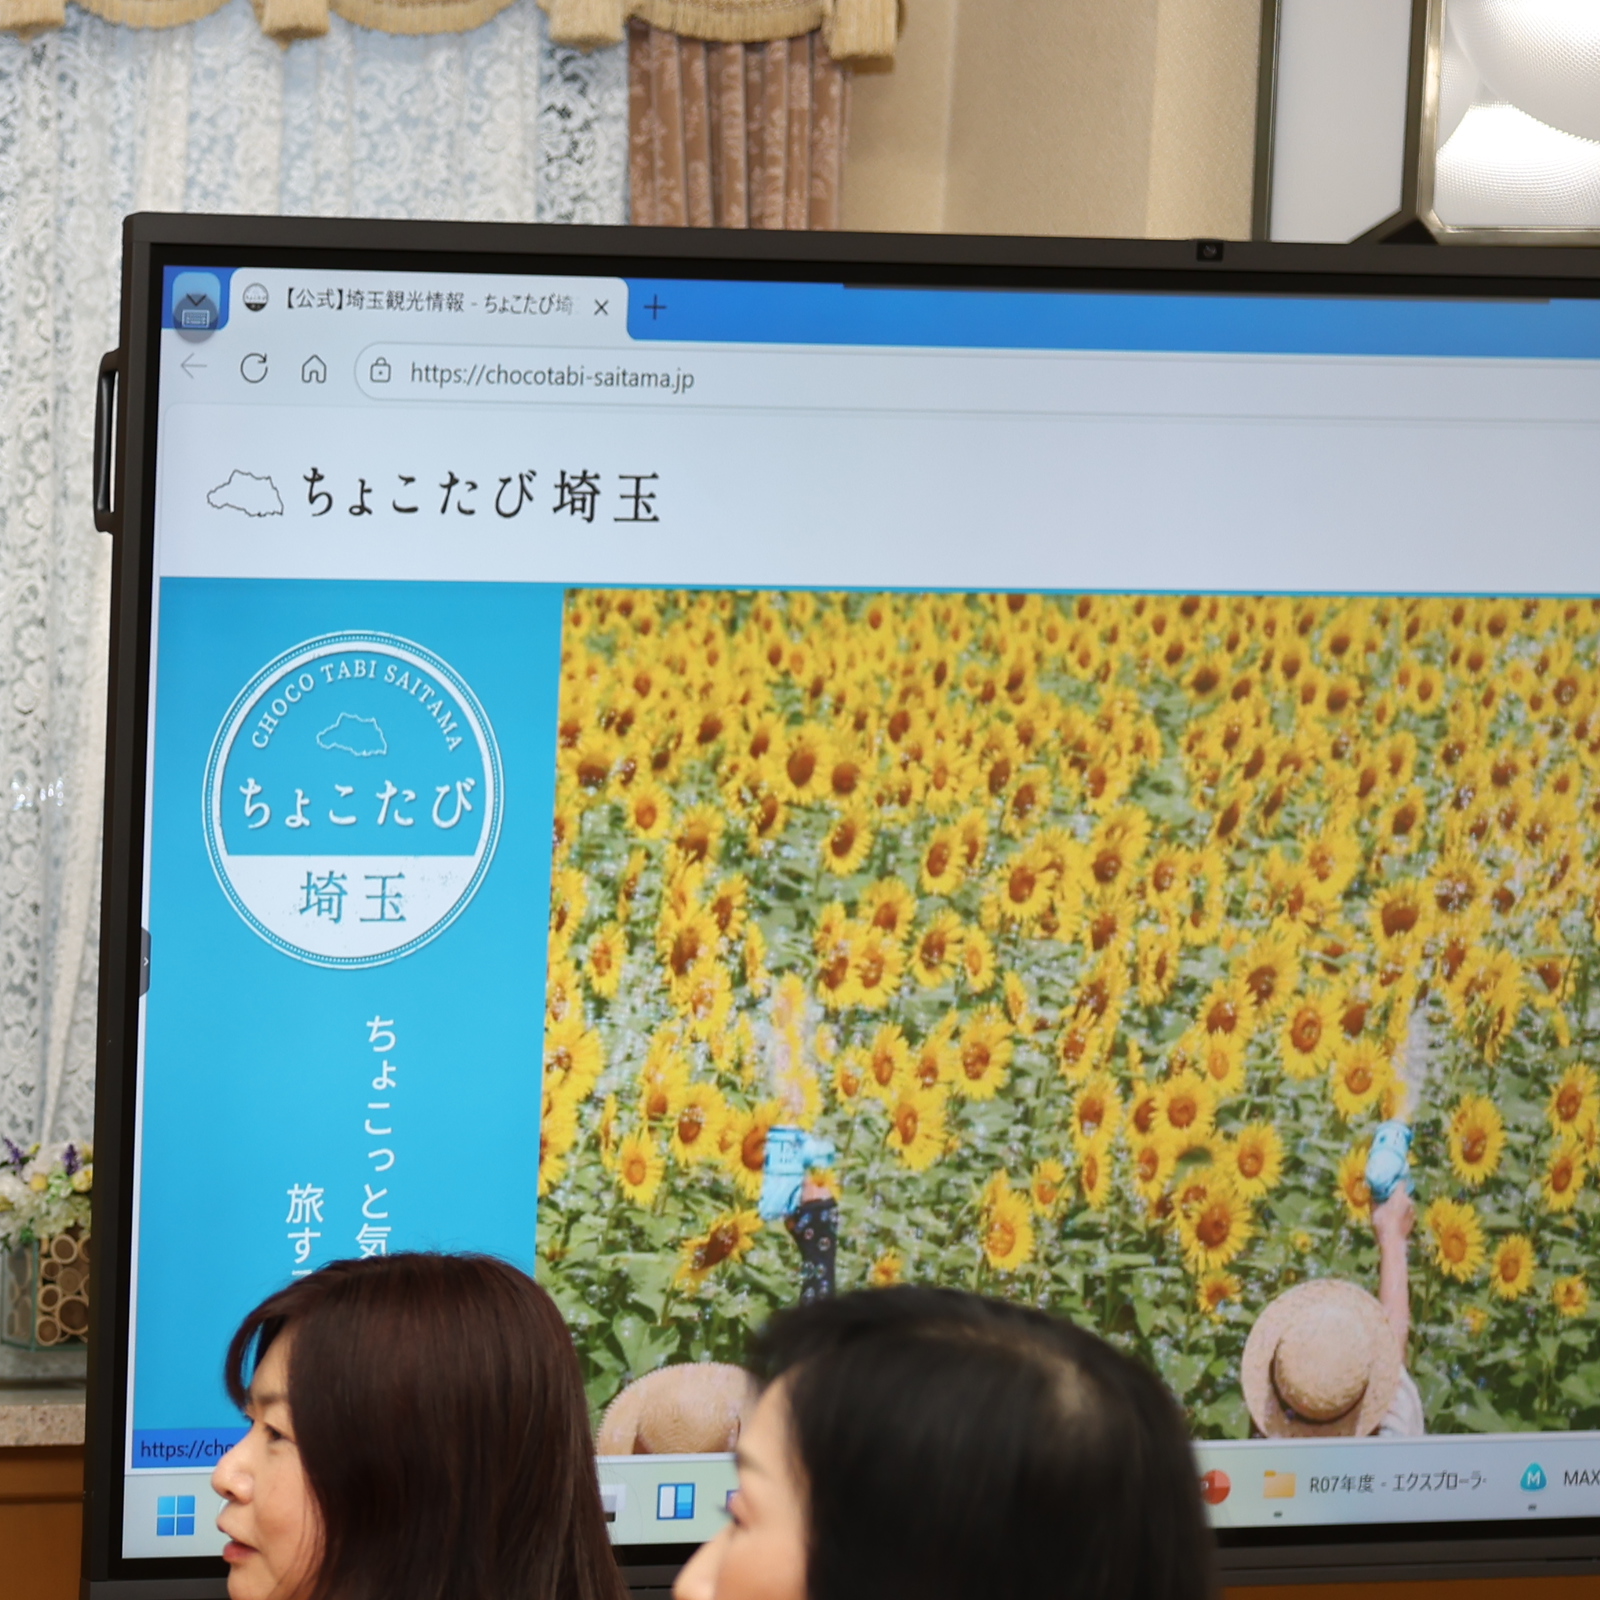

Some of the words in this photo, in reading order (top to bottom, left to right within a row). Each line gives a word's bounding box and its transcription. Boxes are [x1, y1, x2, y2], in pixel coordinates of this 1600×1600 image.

[287, 288, 464, 312] 【公式】埼玉観光情報
[411, 362, 695, 394] https://chocotabi-saitama.jp
[303, 467, 660, 523] ちょこたび埼玉
[252, 673, 314, 748] CHOCO
[320, 659, 377, 683] TABI
[384, 664, 463, 751] SAITAMA
[239, 777, 476, 828] ちょこたび
[300, 869, 407, 924] 埼玉
[355, 1014, 397, 1259] ちょこっと気
[286, 1183, 324, 1276] 旅す
[1310, 1474, 1375, 1493] R07年度
[1564, 1470, 1600, 1486] MAX
